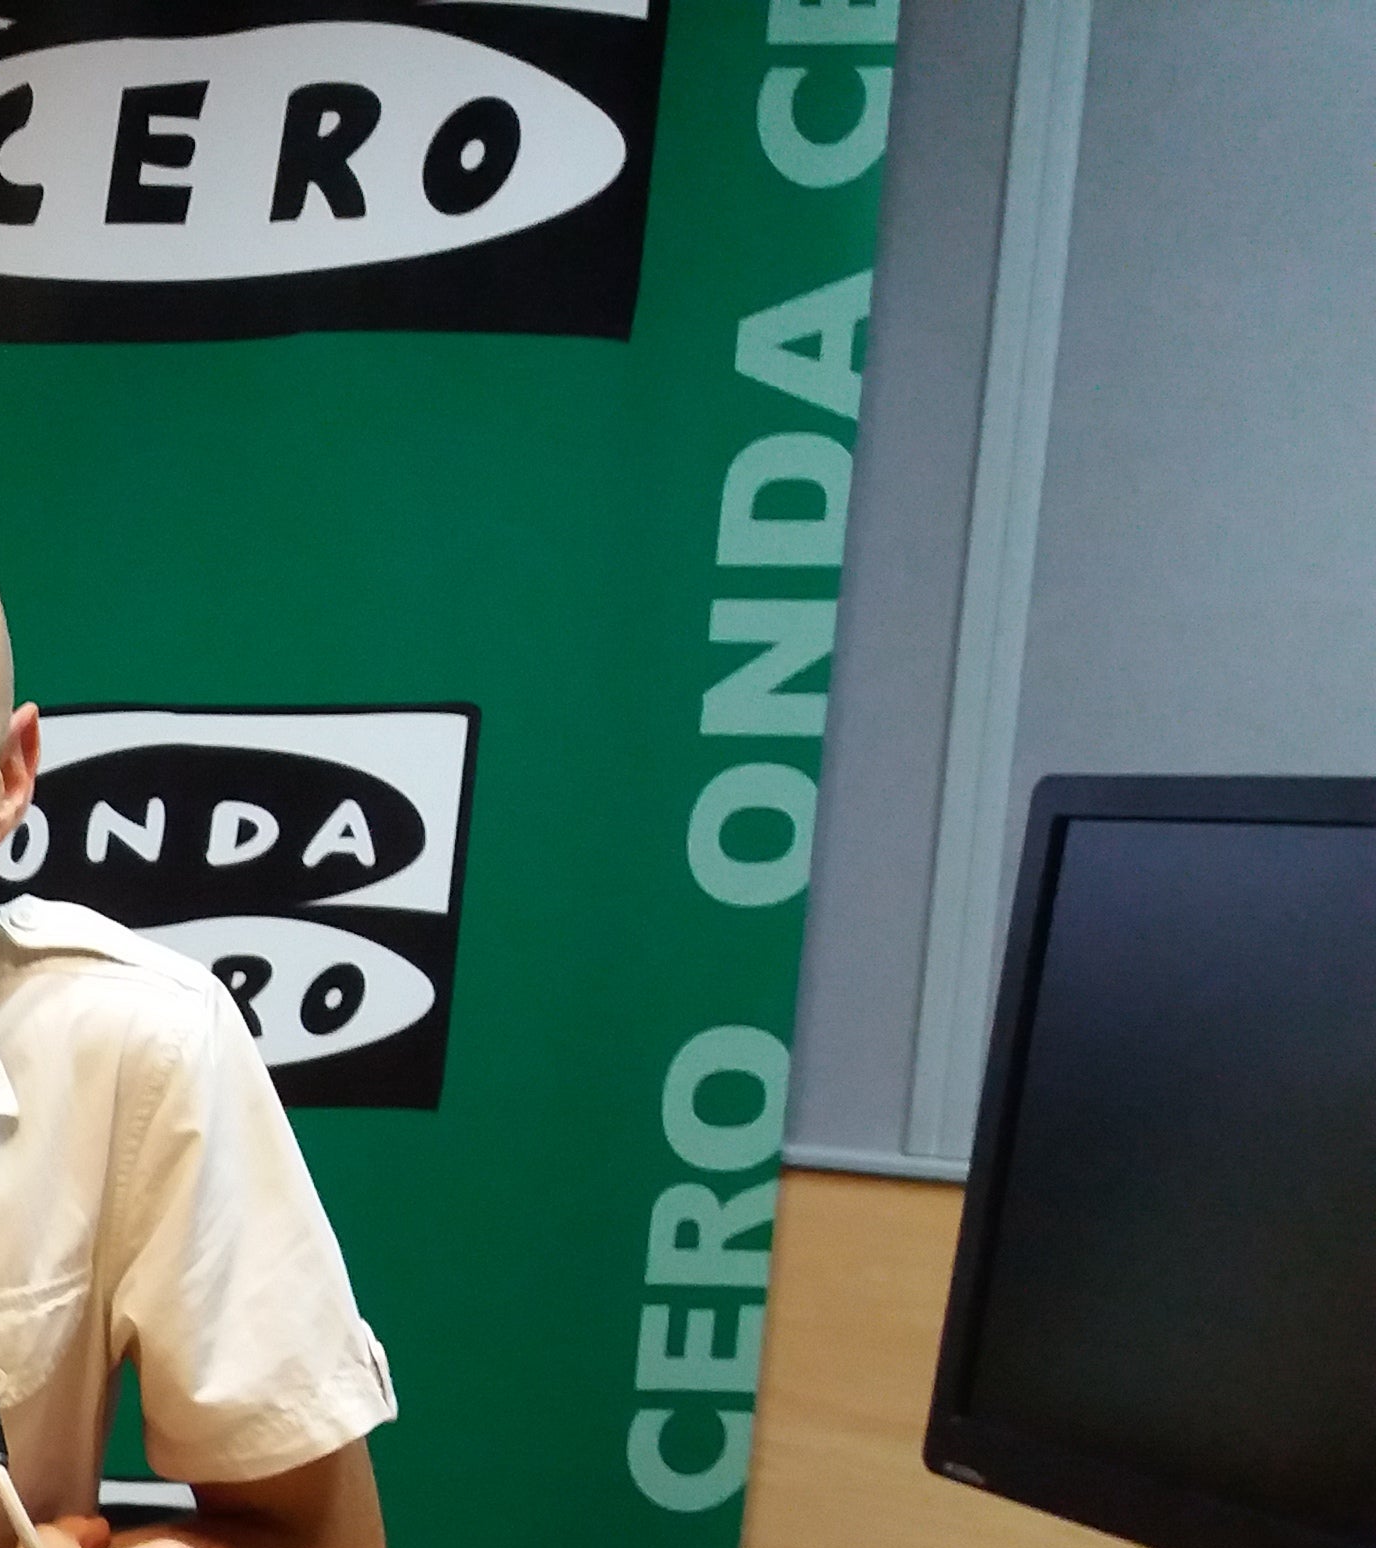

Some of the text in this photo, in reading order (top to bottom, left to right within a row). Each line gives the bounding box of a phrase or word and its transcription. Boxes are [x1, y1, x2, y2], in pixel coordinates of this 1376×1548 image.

[686, 268, 875, 908] ONDA
[210, 953, 367, 1038] RO
[626, 1024, 791, 1513] CERO
